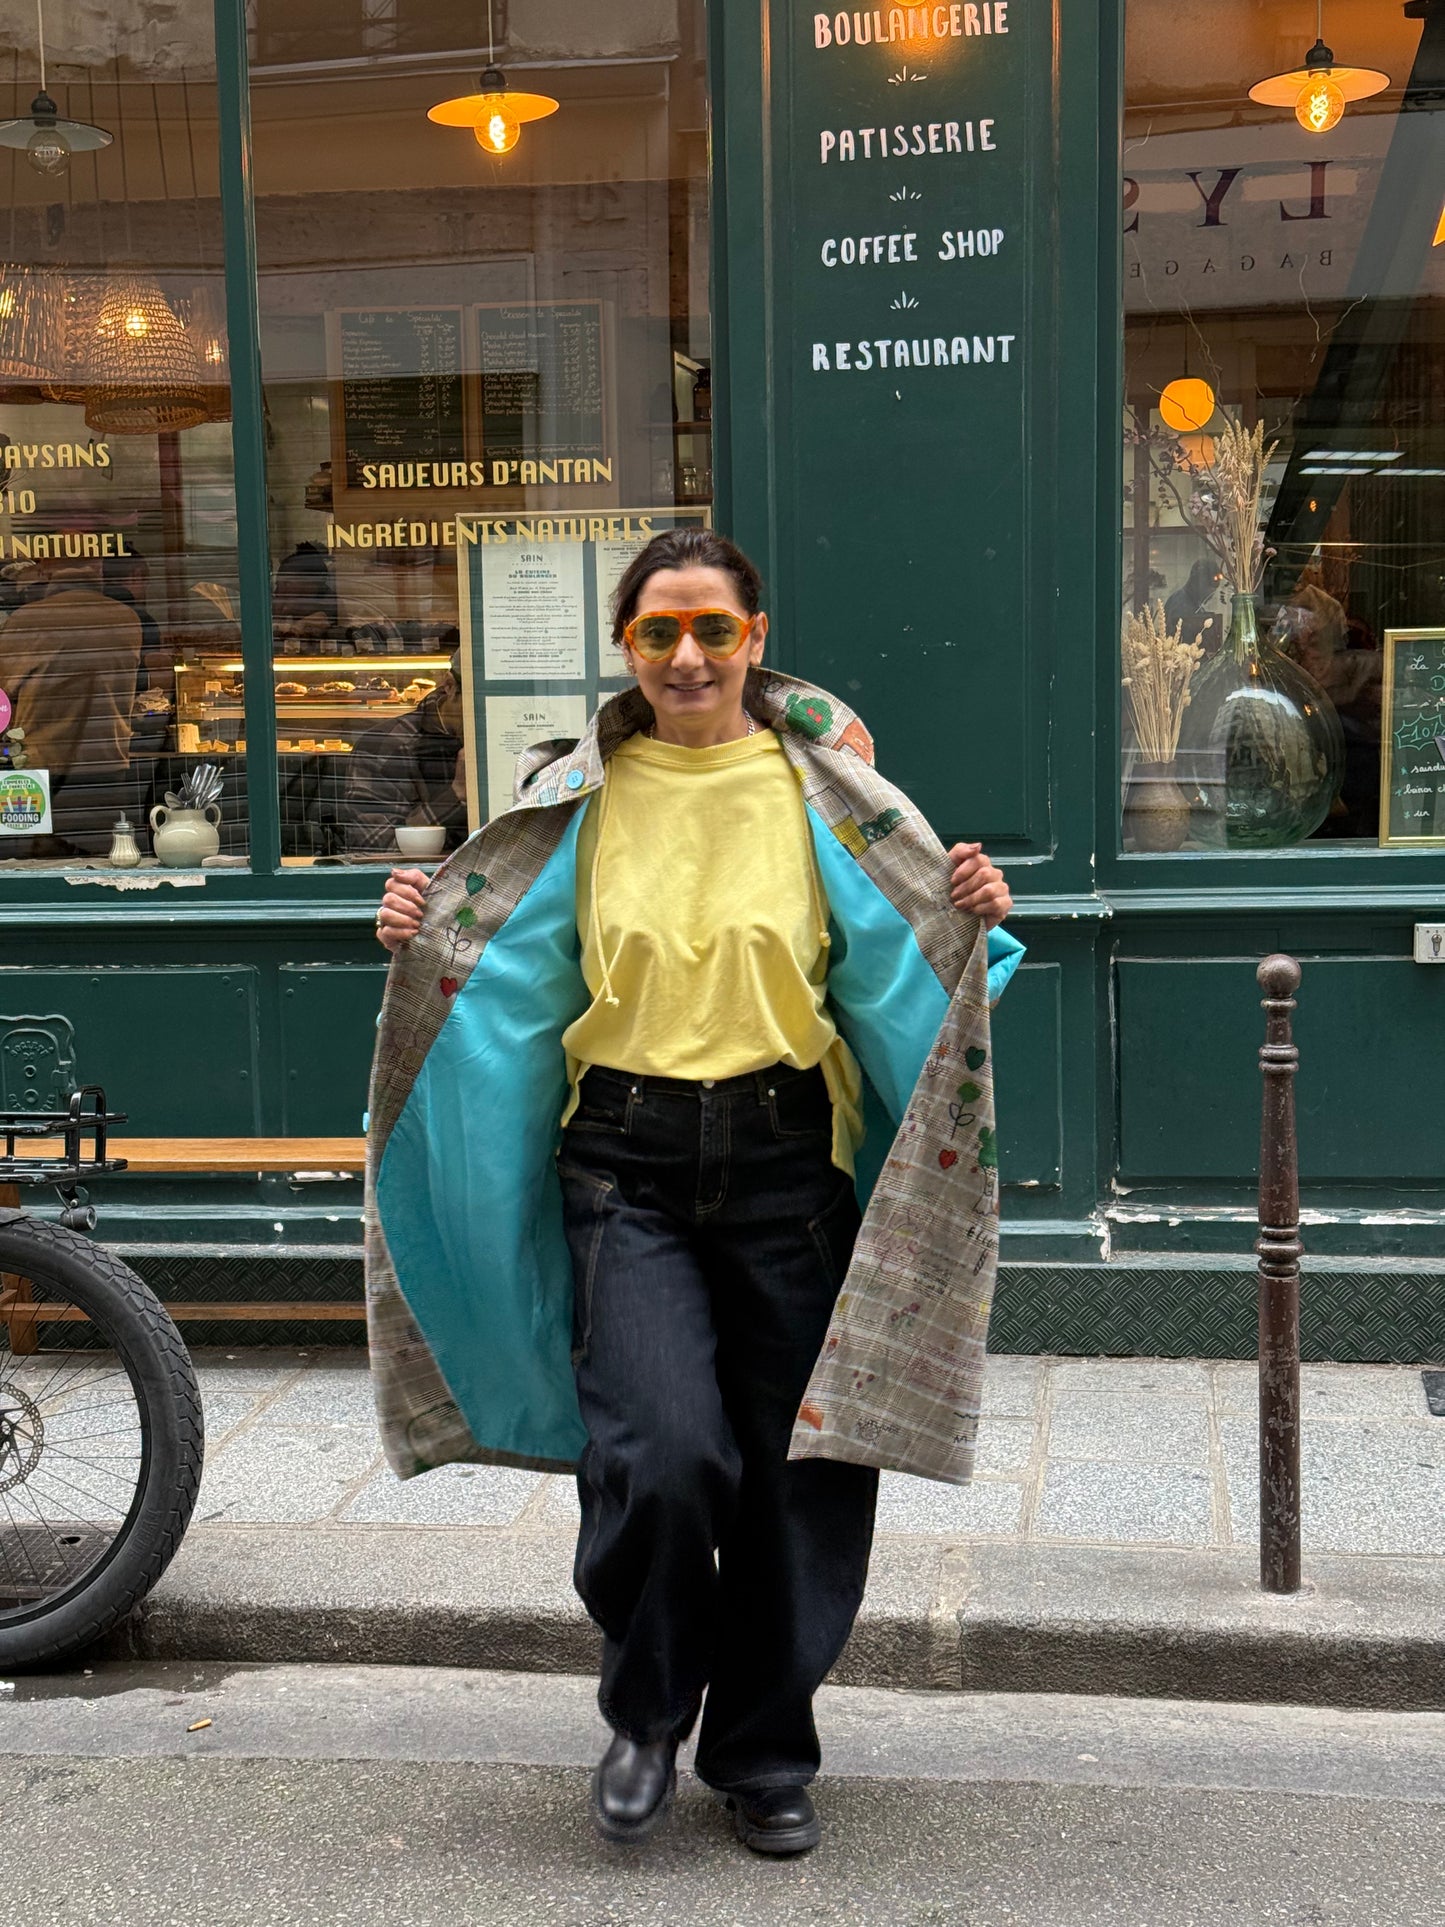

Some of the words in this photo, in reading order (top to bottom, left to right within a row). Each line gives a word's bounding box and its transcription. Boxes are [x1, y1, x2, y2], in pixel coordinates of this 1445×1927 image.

[813, 1, 1009, 49] BOULANGERIE
[819, 118, 997, 164] PATISSERIE
[820, 232, 918, 268] COFFEE
[937, 228, 1005, 261] SHOP
[811, 334, 1016, 372] RESTAURANT
[0, 442, 111, 469] AYSANS
[362, 461, 485, 489] SAVEURS
[492, 457, 612, 486] D'ANTAN
[0, 490, 37, 514] IO
[12, 533, 132, 559] NATUREL
[327, 518, 508, 549] INGRÉDIENTS
[516, 516, 653, 544] NATURELS
[521, 554, 543, 562] SAIN
[523, 713, 546, 722] SAIN
[2, 813, 39, 823] FOODING
